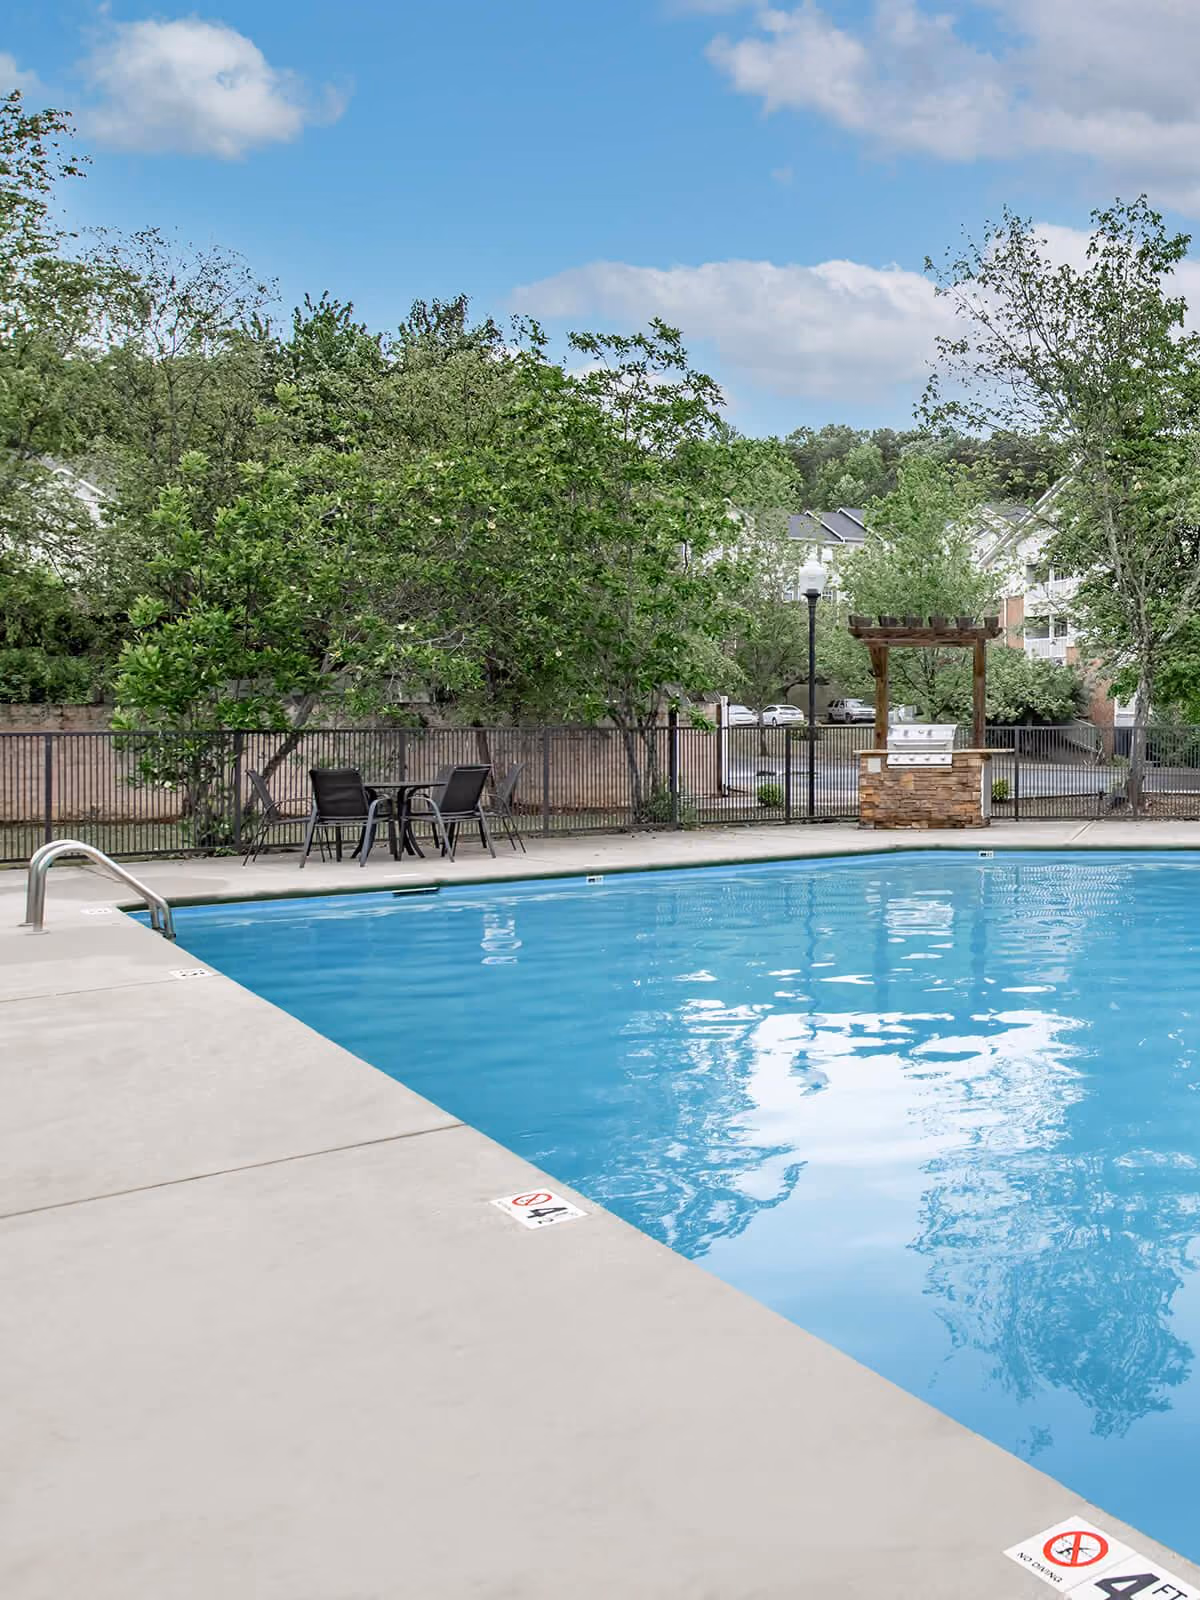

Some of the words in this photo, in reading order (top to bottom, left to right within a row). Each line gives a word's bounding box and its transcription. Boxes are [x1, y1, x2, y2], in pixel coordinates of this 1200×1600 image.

[526, 1206, 568, 1219] 4
[1016, 1552, 1032, 1562] NO
[1031, 1561, 1063, 1583] DIVING
[1093, 1572, 1161, 1600] 4
[1151, 1583, 1188, 1600] FT
